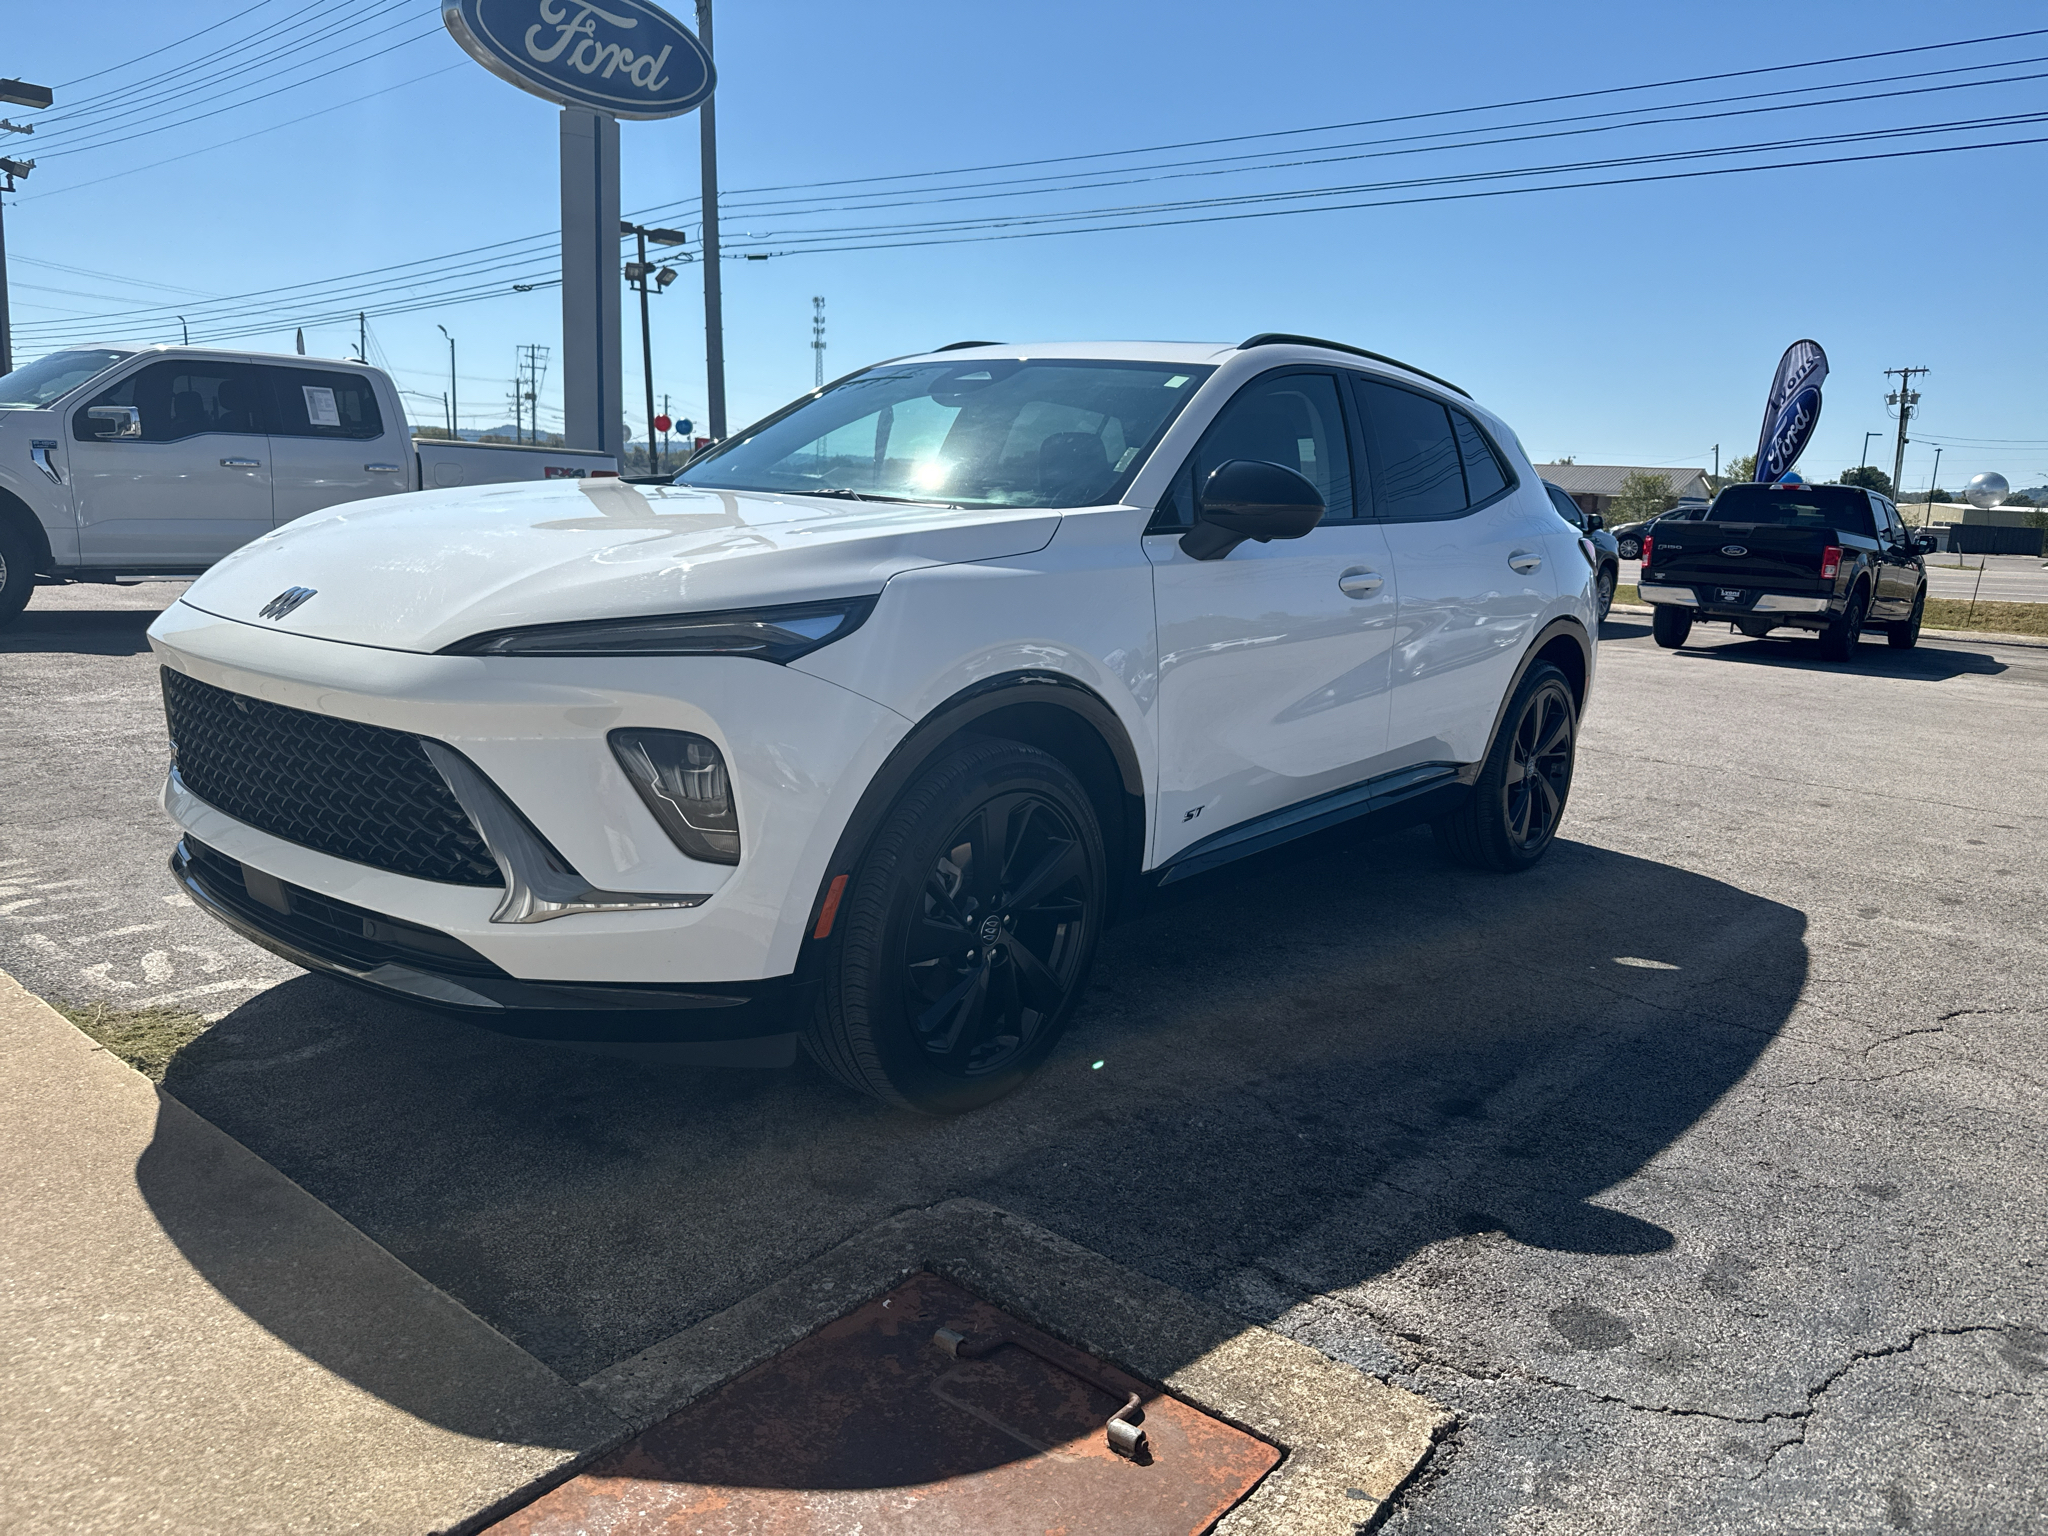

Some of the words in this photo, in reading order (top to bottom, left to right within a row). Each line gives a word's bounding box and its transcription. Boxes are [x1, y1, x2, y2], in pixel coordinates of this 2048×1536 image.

[525, 0, 673, 92] Ford
[1770, 355, 1816, 411] Lyons
[1768, 402, 1810, 475] Ford
[544, 466, 587, 479] FX4
[1725, 546, 1743, 555] Ford
[1182, 804, 1206, 823] ST
